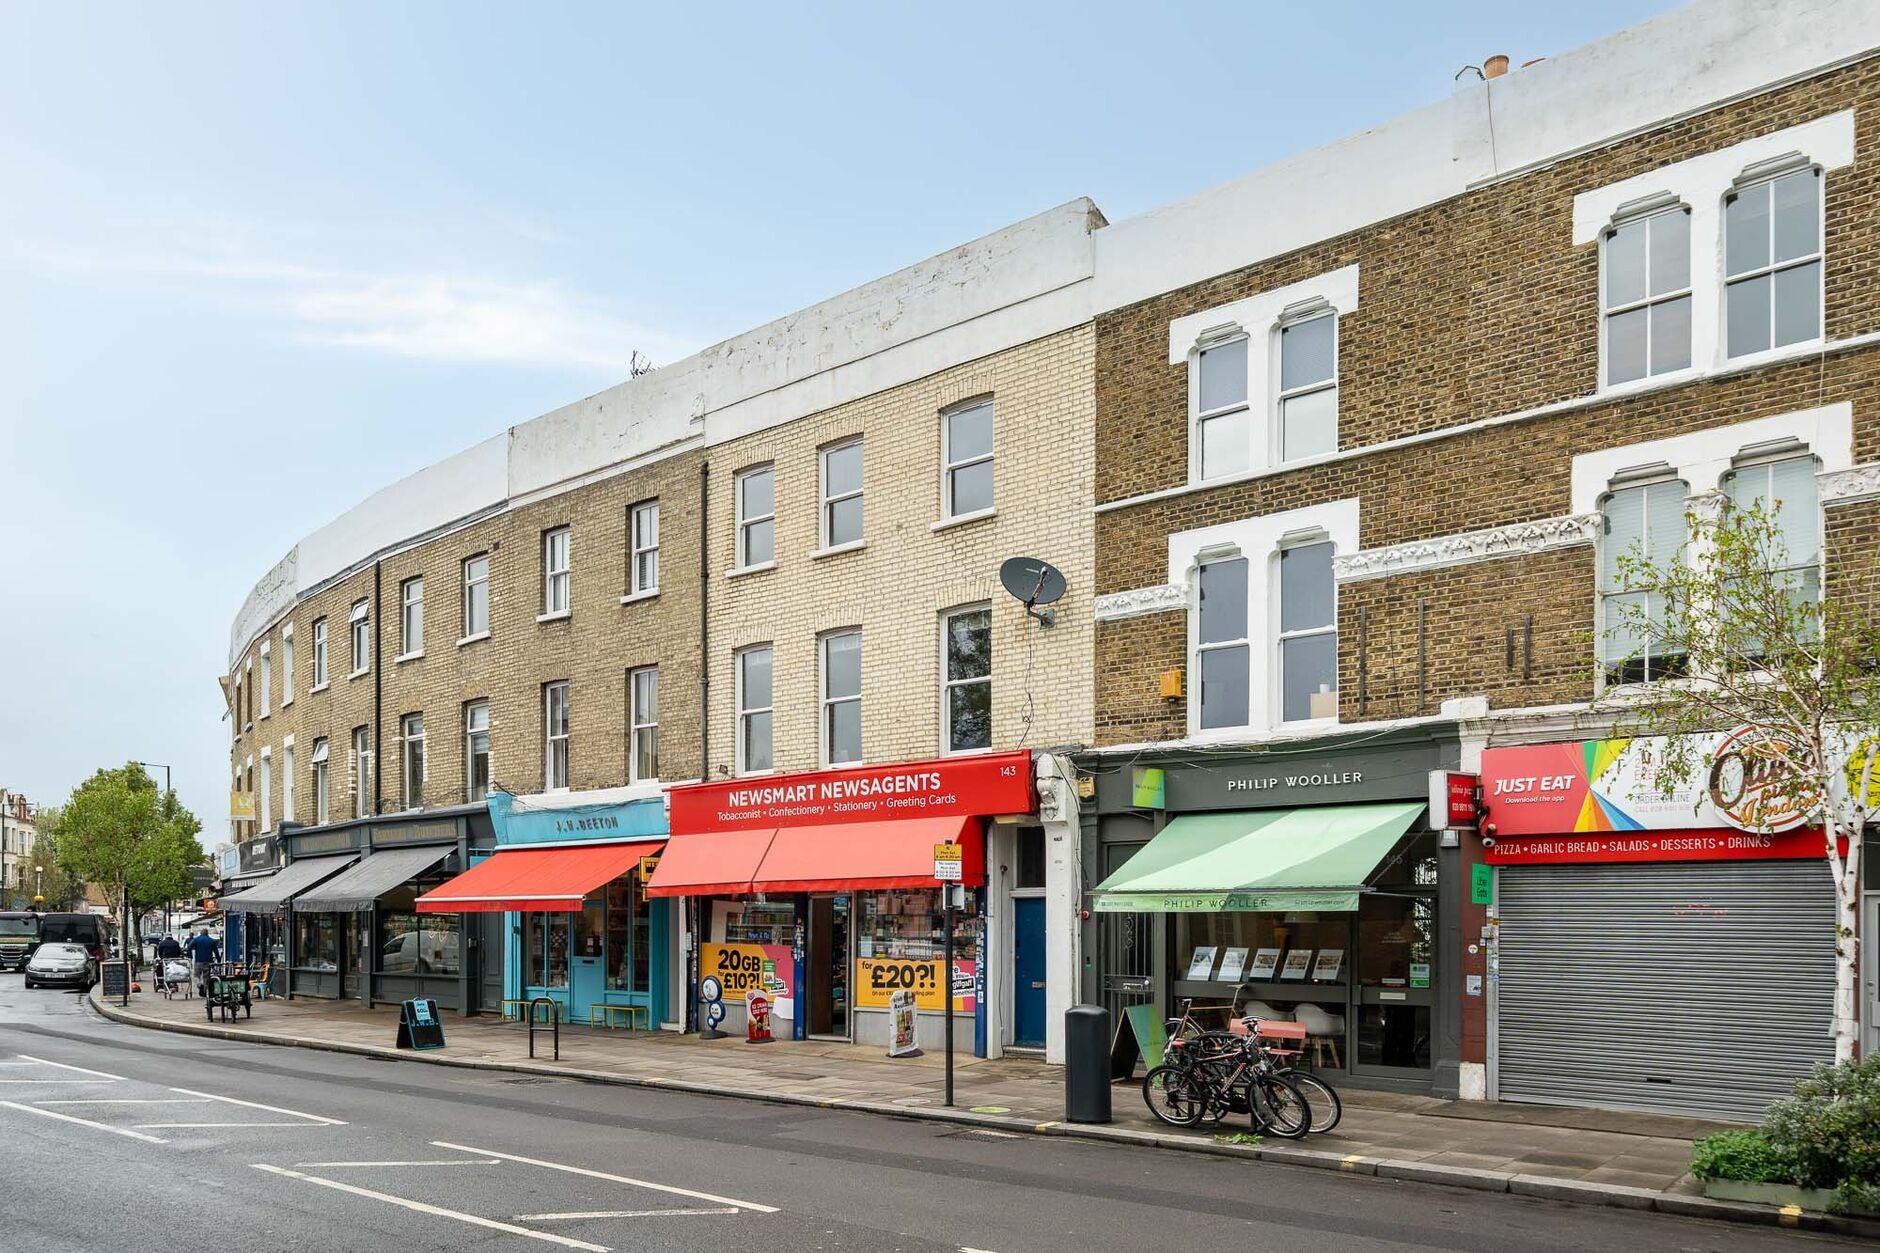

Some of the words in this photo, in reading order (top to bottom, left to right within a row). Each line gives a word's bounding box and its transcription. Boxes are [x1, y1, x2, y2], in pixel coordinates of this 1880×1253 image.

[1000, 766, 1016, 777] 143
[729, 784, 816, 807] NEWSMART
[821, 772, 941, 799] NEWSAGENTS
[1228, 778, 1278, 790] PHILIP
[1285, 772, 1362, 787] WOOLLER
[1494, 777, 1537, 795] JUST
[1540, 775, 1576, 791] EAT
[717, 809, 761, 821] Tobacconist
[769, 805, 825, 818] Confectionery
[833, 800, 877, 813] Stationery
[887, 796, 926, 808] Greeting
[929, 793, 957, 804] Cards
[1505, 796, 1538, 804] Download
[1494, 844, 1521, 855] PIZZA
[1530, 843, 1564, 854] GARLIC
[1567, 842, 1599, 853] BREAD
[1609, 840, 1649, 852] SALADS
[1660, 838, 1716, 851] DESSERTS
[1727, 836, 1771, 849] DRINKS
[1164, 900, 1203, 908] PHILIP
[1210, 898, 1268, 908] WOOLLER
[718, 949, 760, 972] 20GB
[862, 961, 872, 970] for
[723, 973, 760, 989] £10?!
[872, 964, 936, 988] £20?!
